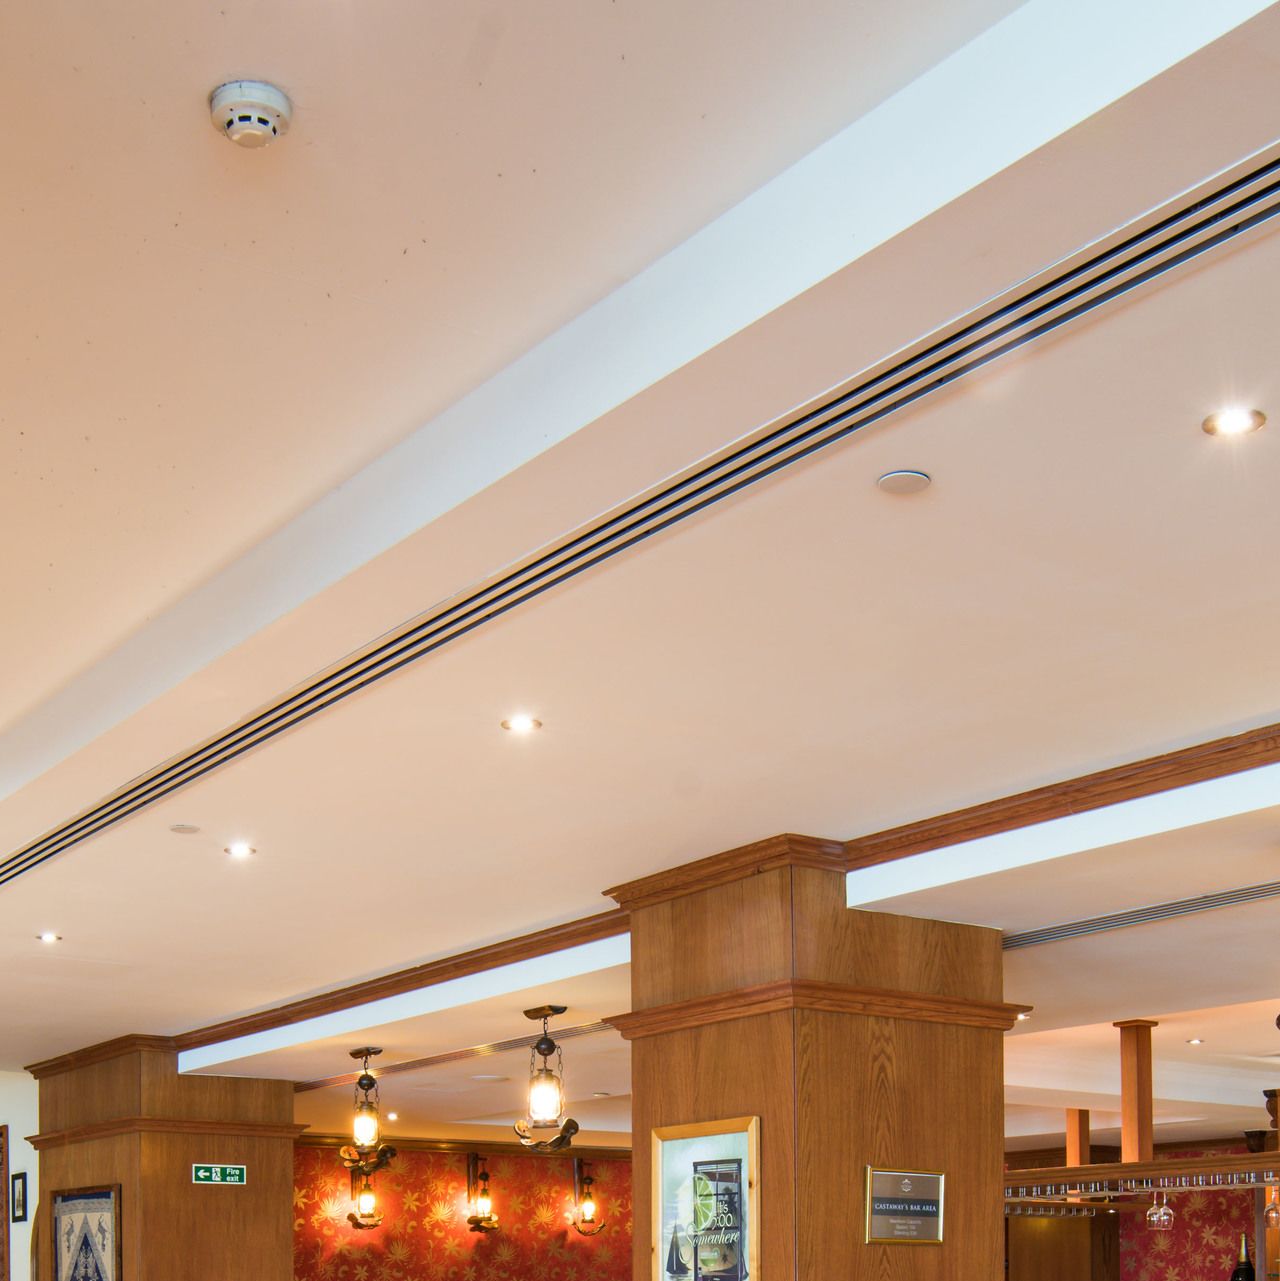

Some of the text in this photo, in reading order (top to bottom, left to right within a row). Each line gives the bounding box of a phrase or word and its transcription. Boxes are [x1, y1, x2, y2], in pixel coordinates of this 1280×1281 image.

[226, 1167, 240, 1175] Fire
[910, 1203, 920, 1211] BAR
[922, 1204, 937, 1212] AREA
[683, 1222, 740, 1254] Somewhere
